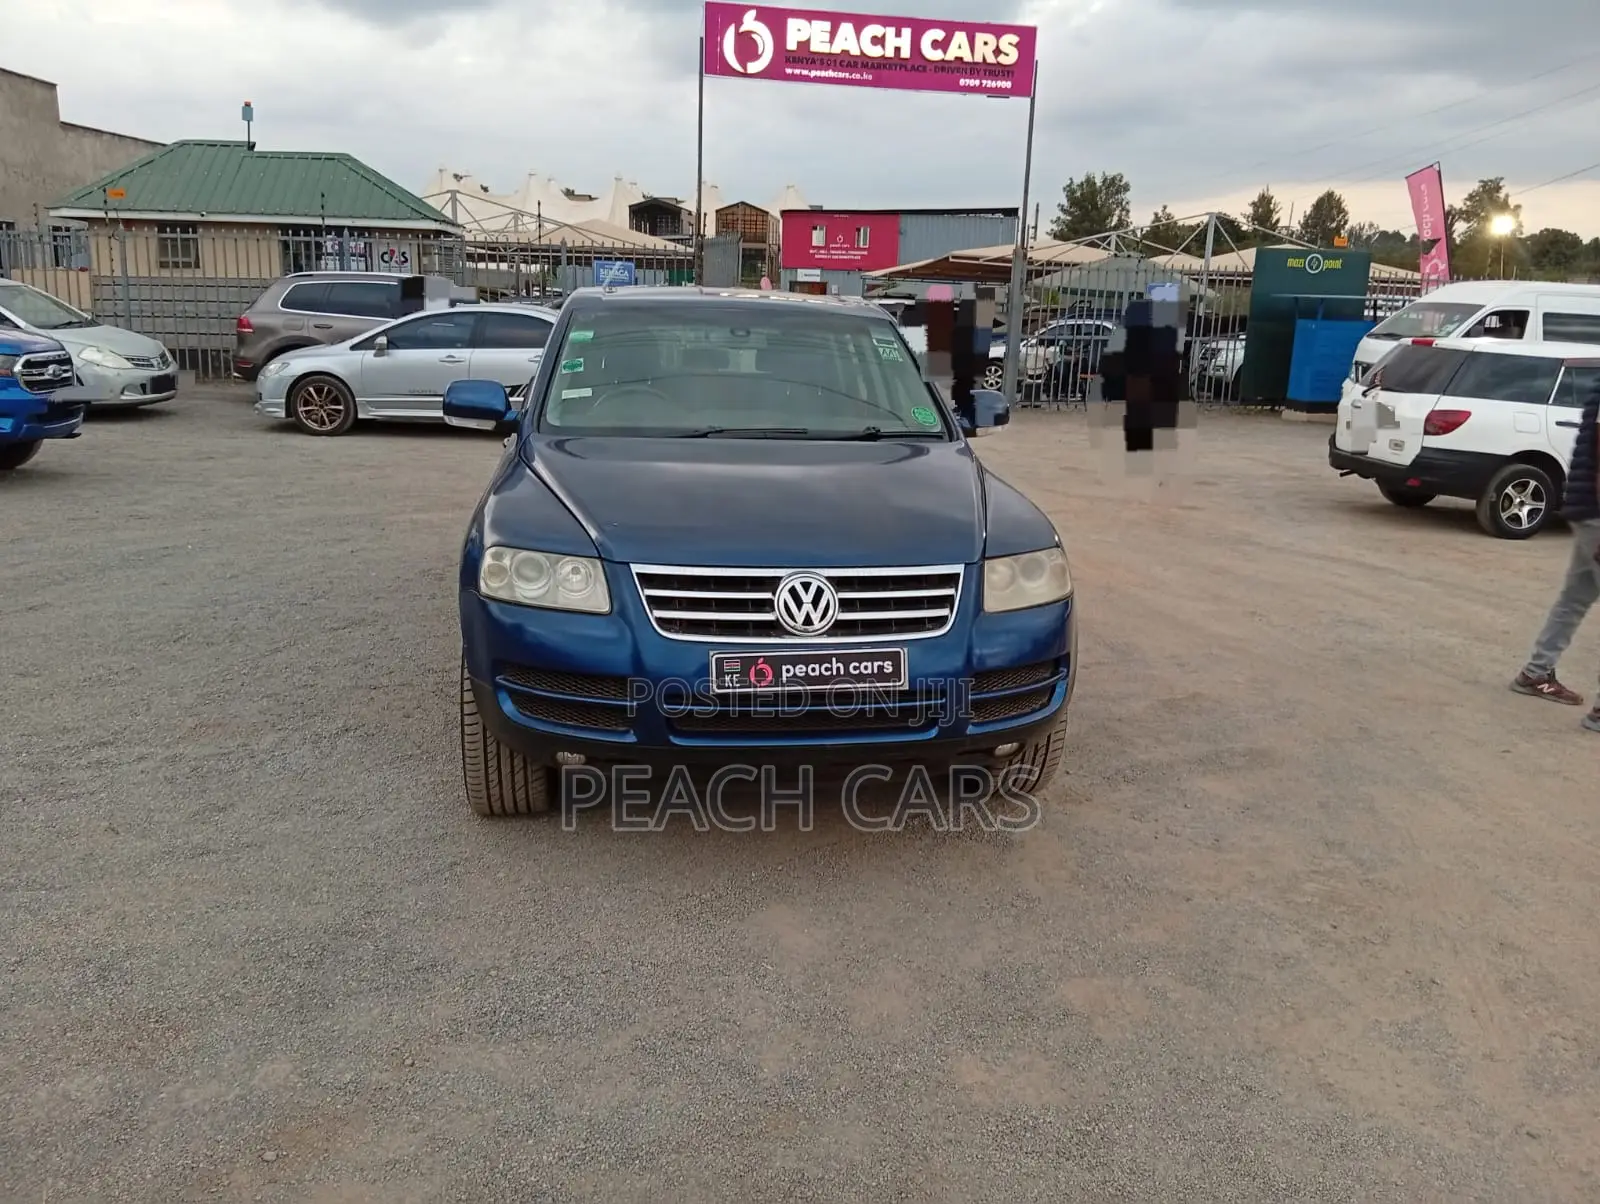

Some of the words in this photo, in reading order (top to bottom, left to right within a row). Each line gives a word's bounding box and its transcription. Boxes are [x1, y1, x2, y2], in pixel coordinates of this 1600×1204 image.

[786, 17, 912, 59] PEACH
[920, 28, 1021, 66] CARS
[785, 55, 824, 66] KENYA'S
[839, 59, 860, 69] CAR
[861, 60, 927, 73] MARKETPLACE
[934, 64, 968, 76] DRIVEN
[969, 66, 981, 77] BY
[983, 67, 1015, 78] TRUST!
[959, 78, 980, 87] 0709
[982, 79, 1012, 89] 726900
[1323, 258, 1343, 271] point
[781, 657, 843, 683] peach
[849, 659, 893, 675] cars
[724, 673, 740, 688] KE
